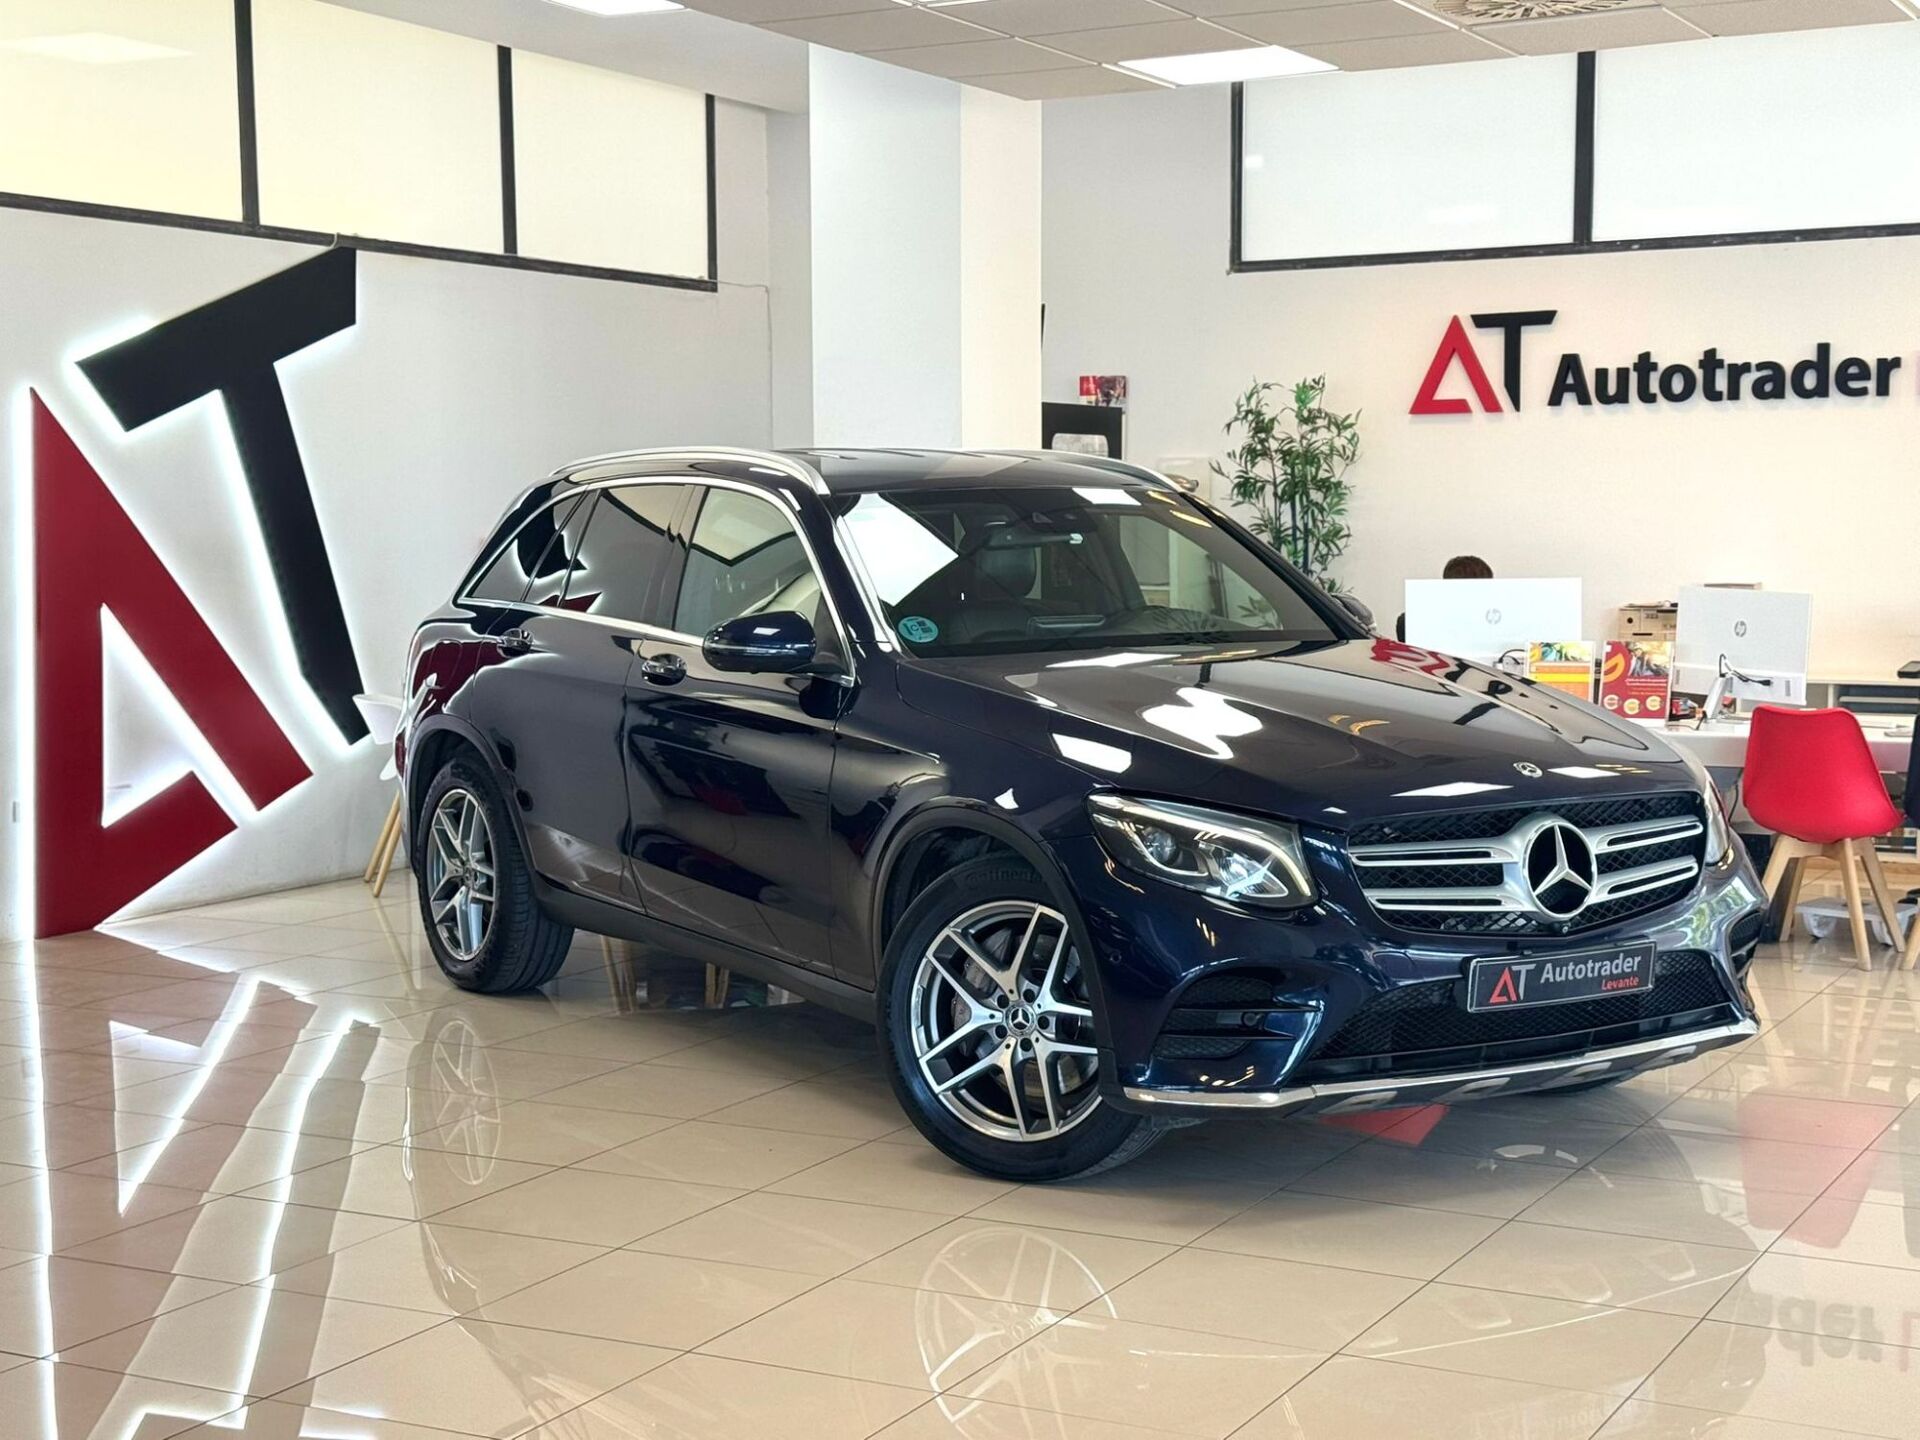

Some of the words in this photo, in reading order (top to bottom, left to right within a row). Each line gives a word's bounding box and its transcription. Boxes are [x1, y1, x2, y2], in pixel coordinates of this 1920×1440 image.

[1409, 309, 1557, 415] AT
[1547, 342, 1902, 407] Autotrader
[1488, 963, 1537, 1004] AT
[1540, 952, 1642, 984] Autotrader
[1601, 975, 1639, 991] Levante
